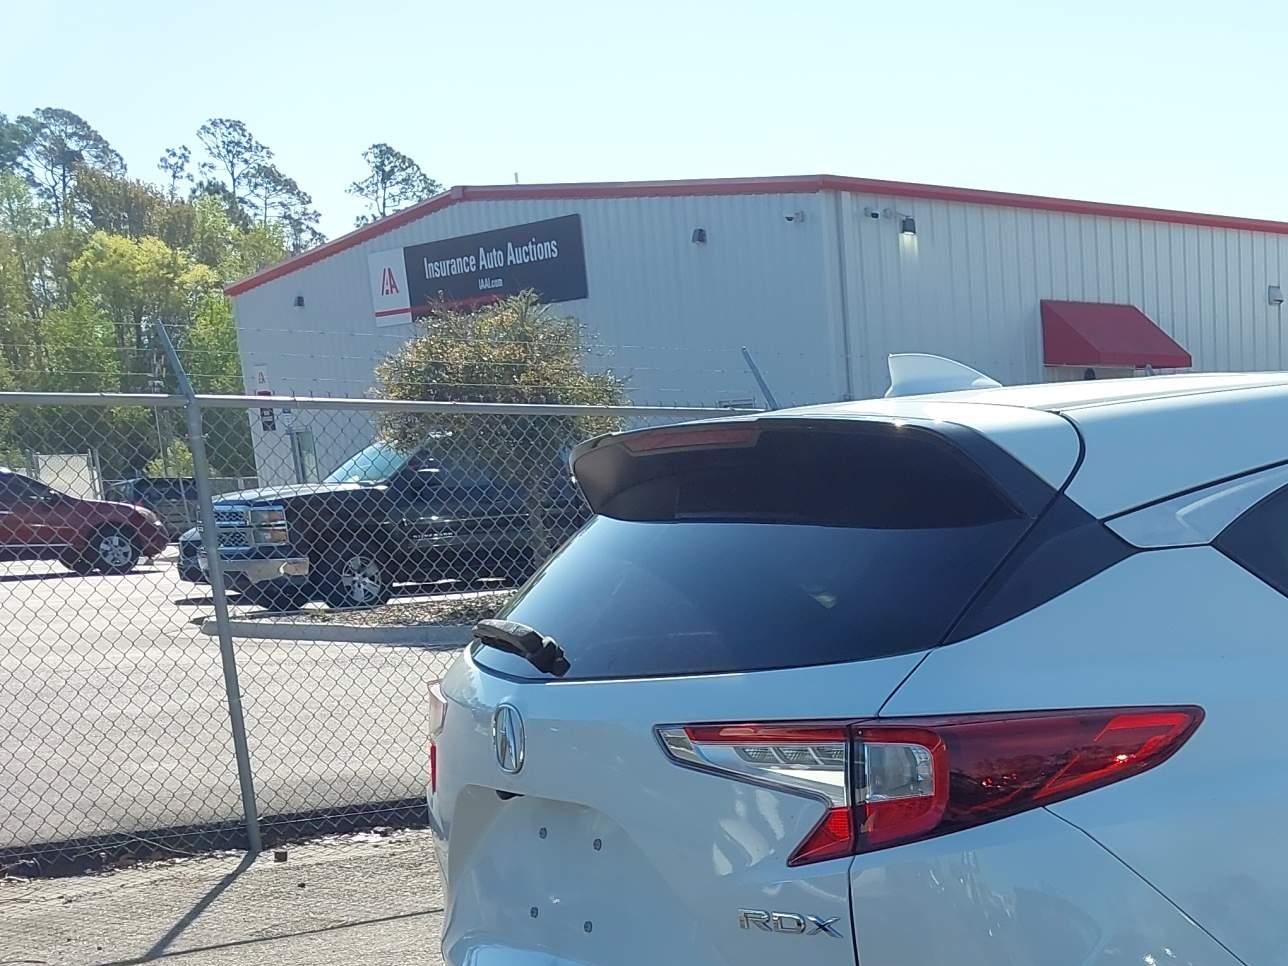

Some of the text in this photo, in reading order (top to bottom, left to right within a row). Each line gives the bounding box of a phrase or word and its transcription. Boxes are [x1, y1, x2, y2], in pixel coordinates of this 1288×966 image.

[424, 237, 559, 279] Insurance Auto Auctions
[737, 908, 844, 938] RDX
